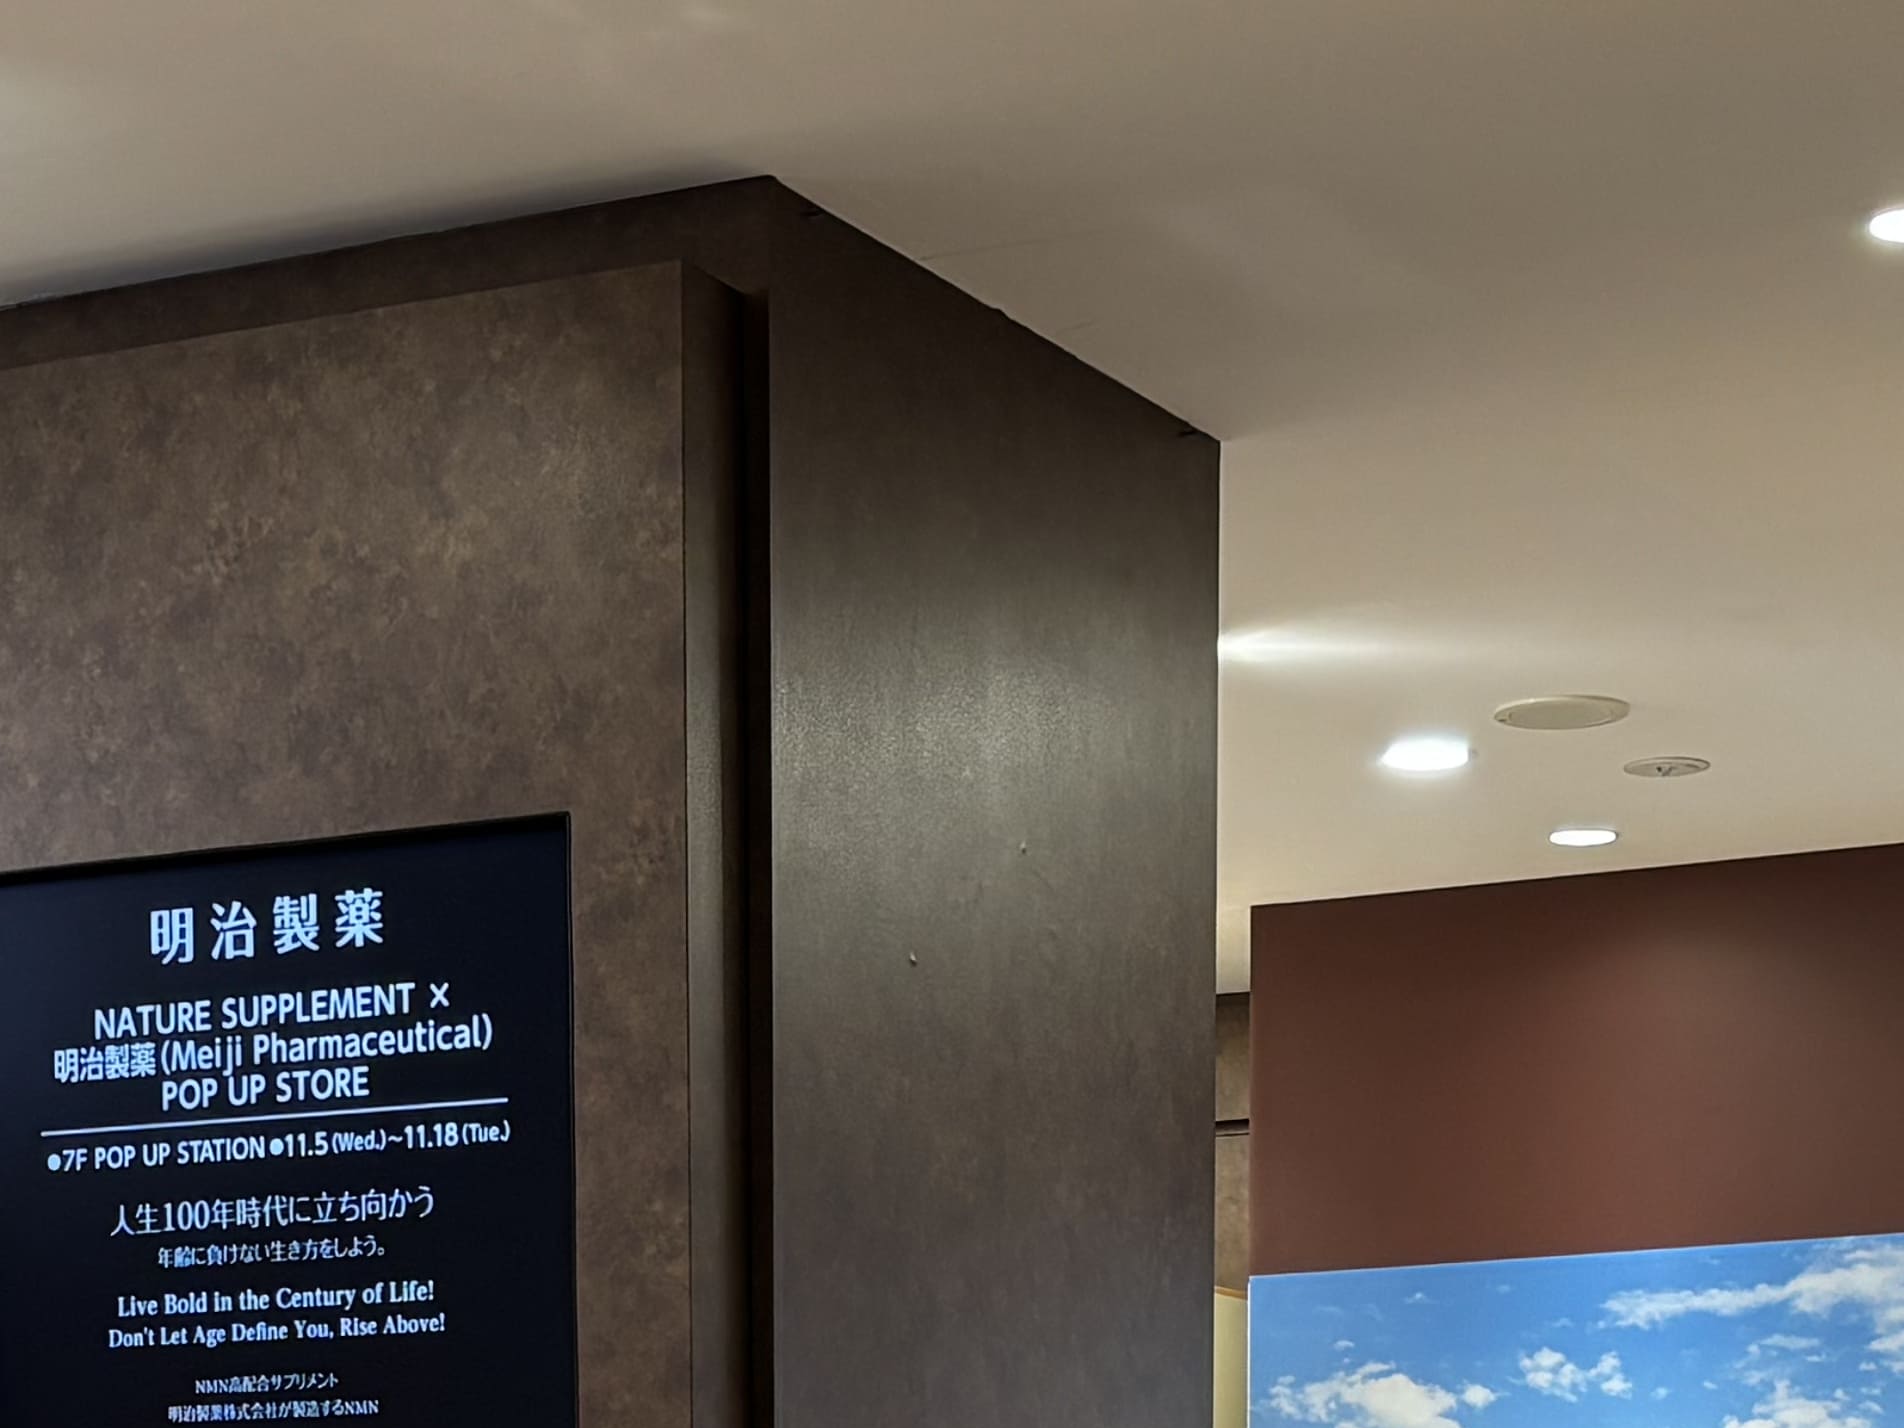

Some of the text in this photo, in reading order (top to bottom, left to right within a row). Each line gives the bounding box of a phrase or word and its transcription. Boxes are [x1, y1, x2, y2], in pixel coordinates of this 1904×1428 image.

[150, 888, 384, 964] 明治製薬
[94, 1000, 212, 1040] NATURE
[222, 982, 414, 1030] SUPPLEMENT
[253, 1013, 492, 1066] Pharmaceutical)
[162, 1066, 370, 1111] POP UP STORE
[95, 1146, 136, 1169] POP
[143, 1143, 170, 1166] UP
[177, 1136, 266, 1163] STATION
[111, 1185, 435, 1237] 人生100年時代に立ち向かう
[158, 1234, 386, 1268] 年齢に負けない生き方をしよう。
[118, 1280, 435, 1318] Live Bold in the Century of Life!
[109, 1313, 446, 1349] Don't Let Age Define You, Rise Above!
